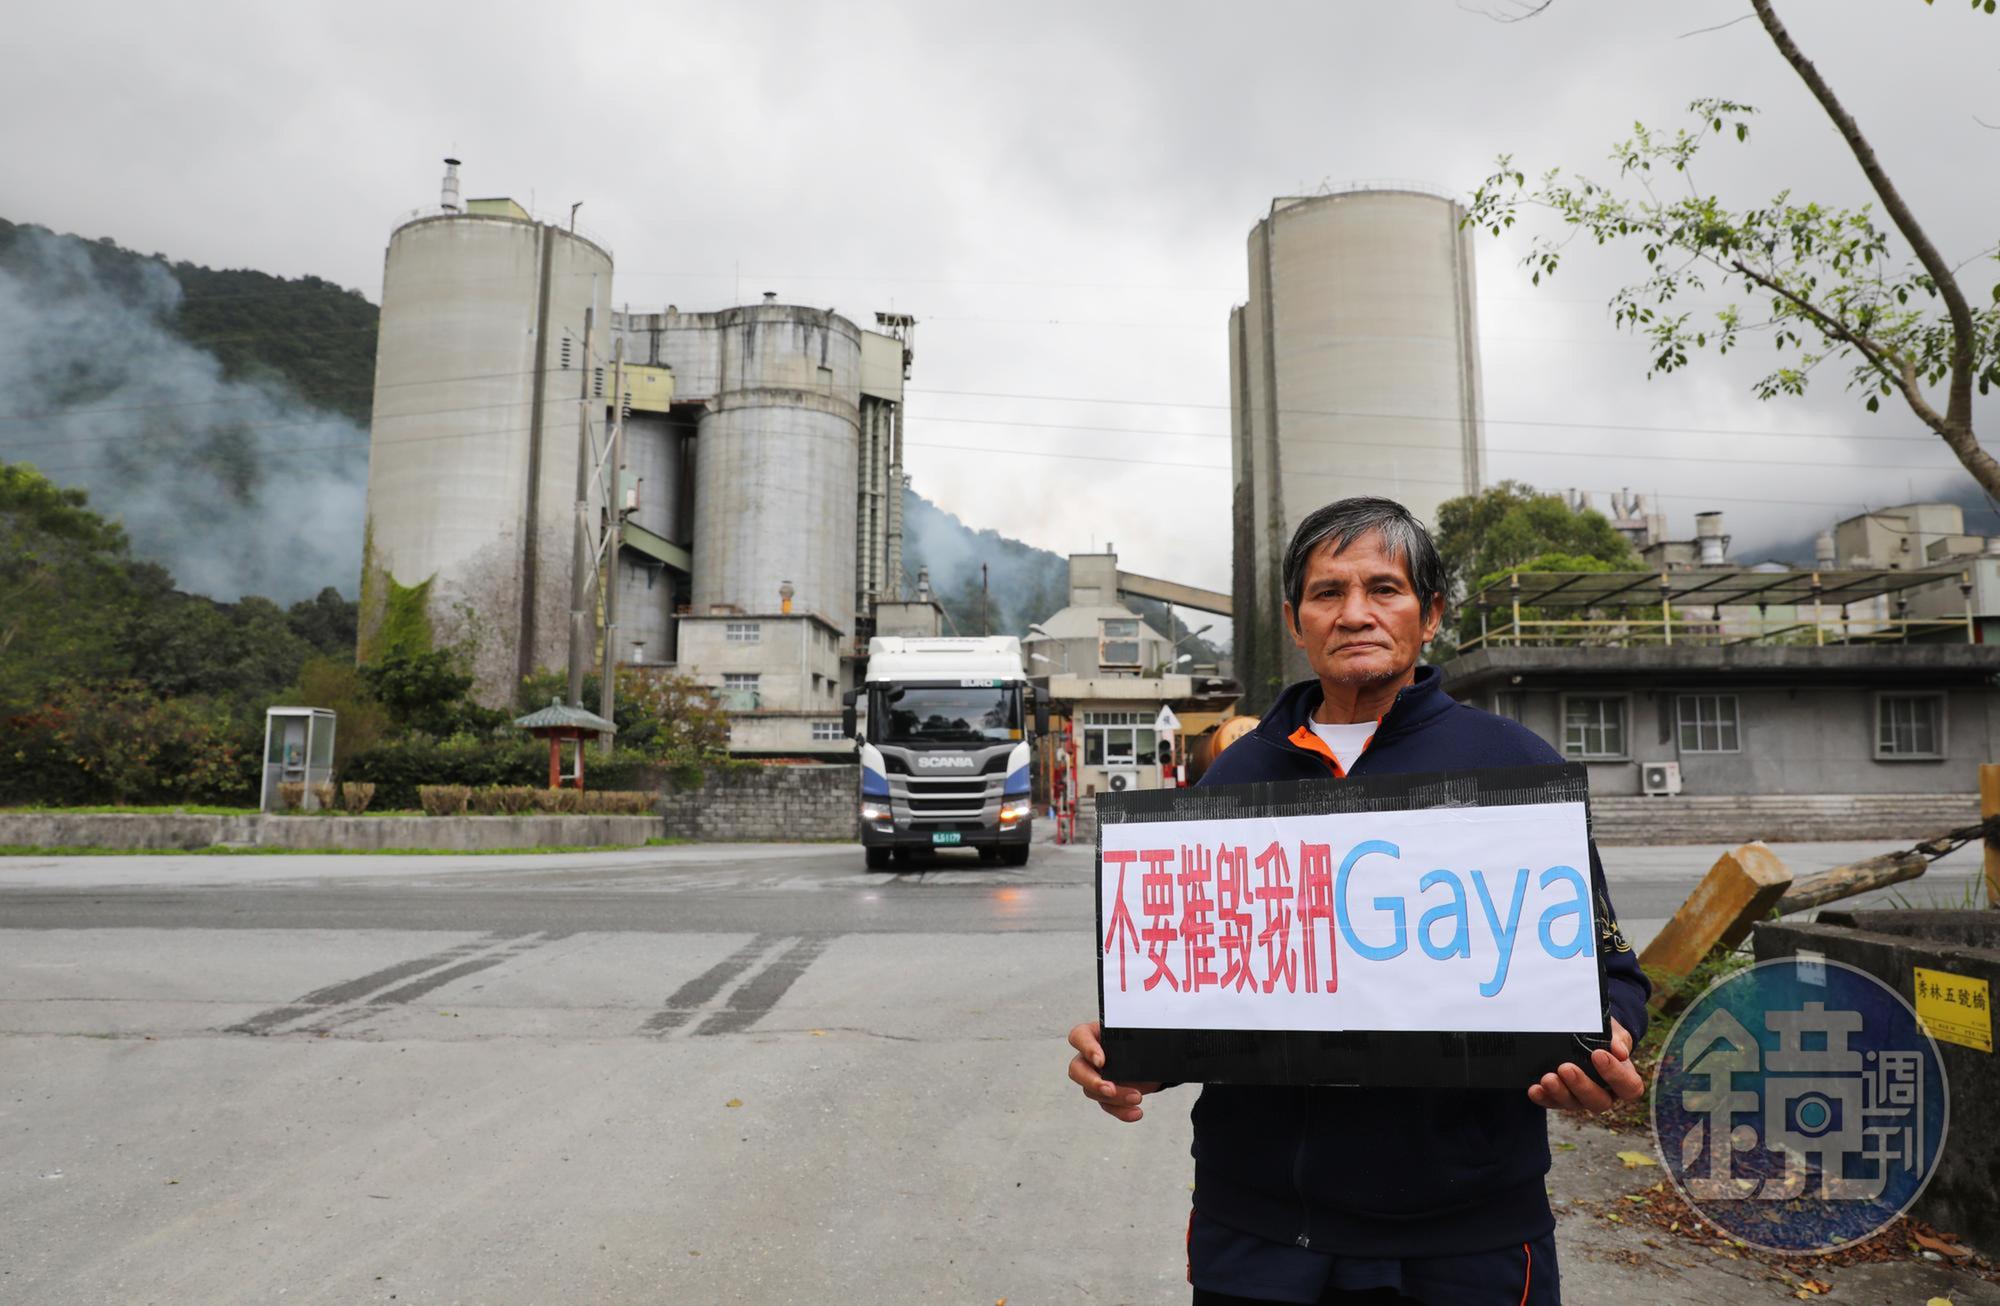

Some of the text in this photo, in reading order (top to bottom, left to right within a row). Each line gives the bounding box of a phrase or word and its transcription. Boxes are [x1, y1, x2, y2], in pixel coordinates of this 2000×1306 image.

[918, 756, 974, 768] SCANIA
[1918, 980, 1986, 1011] 秀林五號橋
